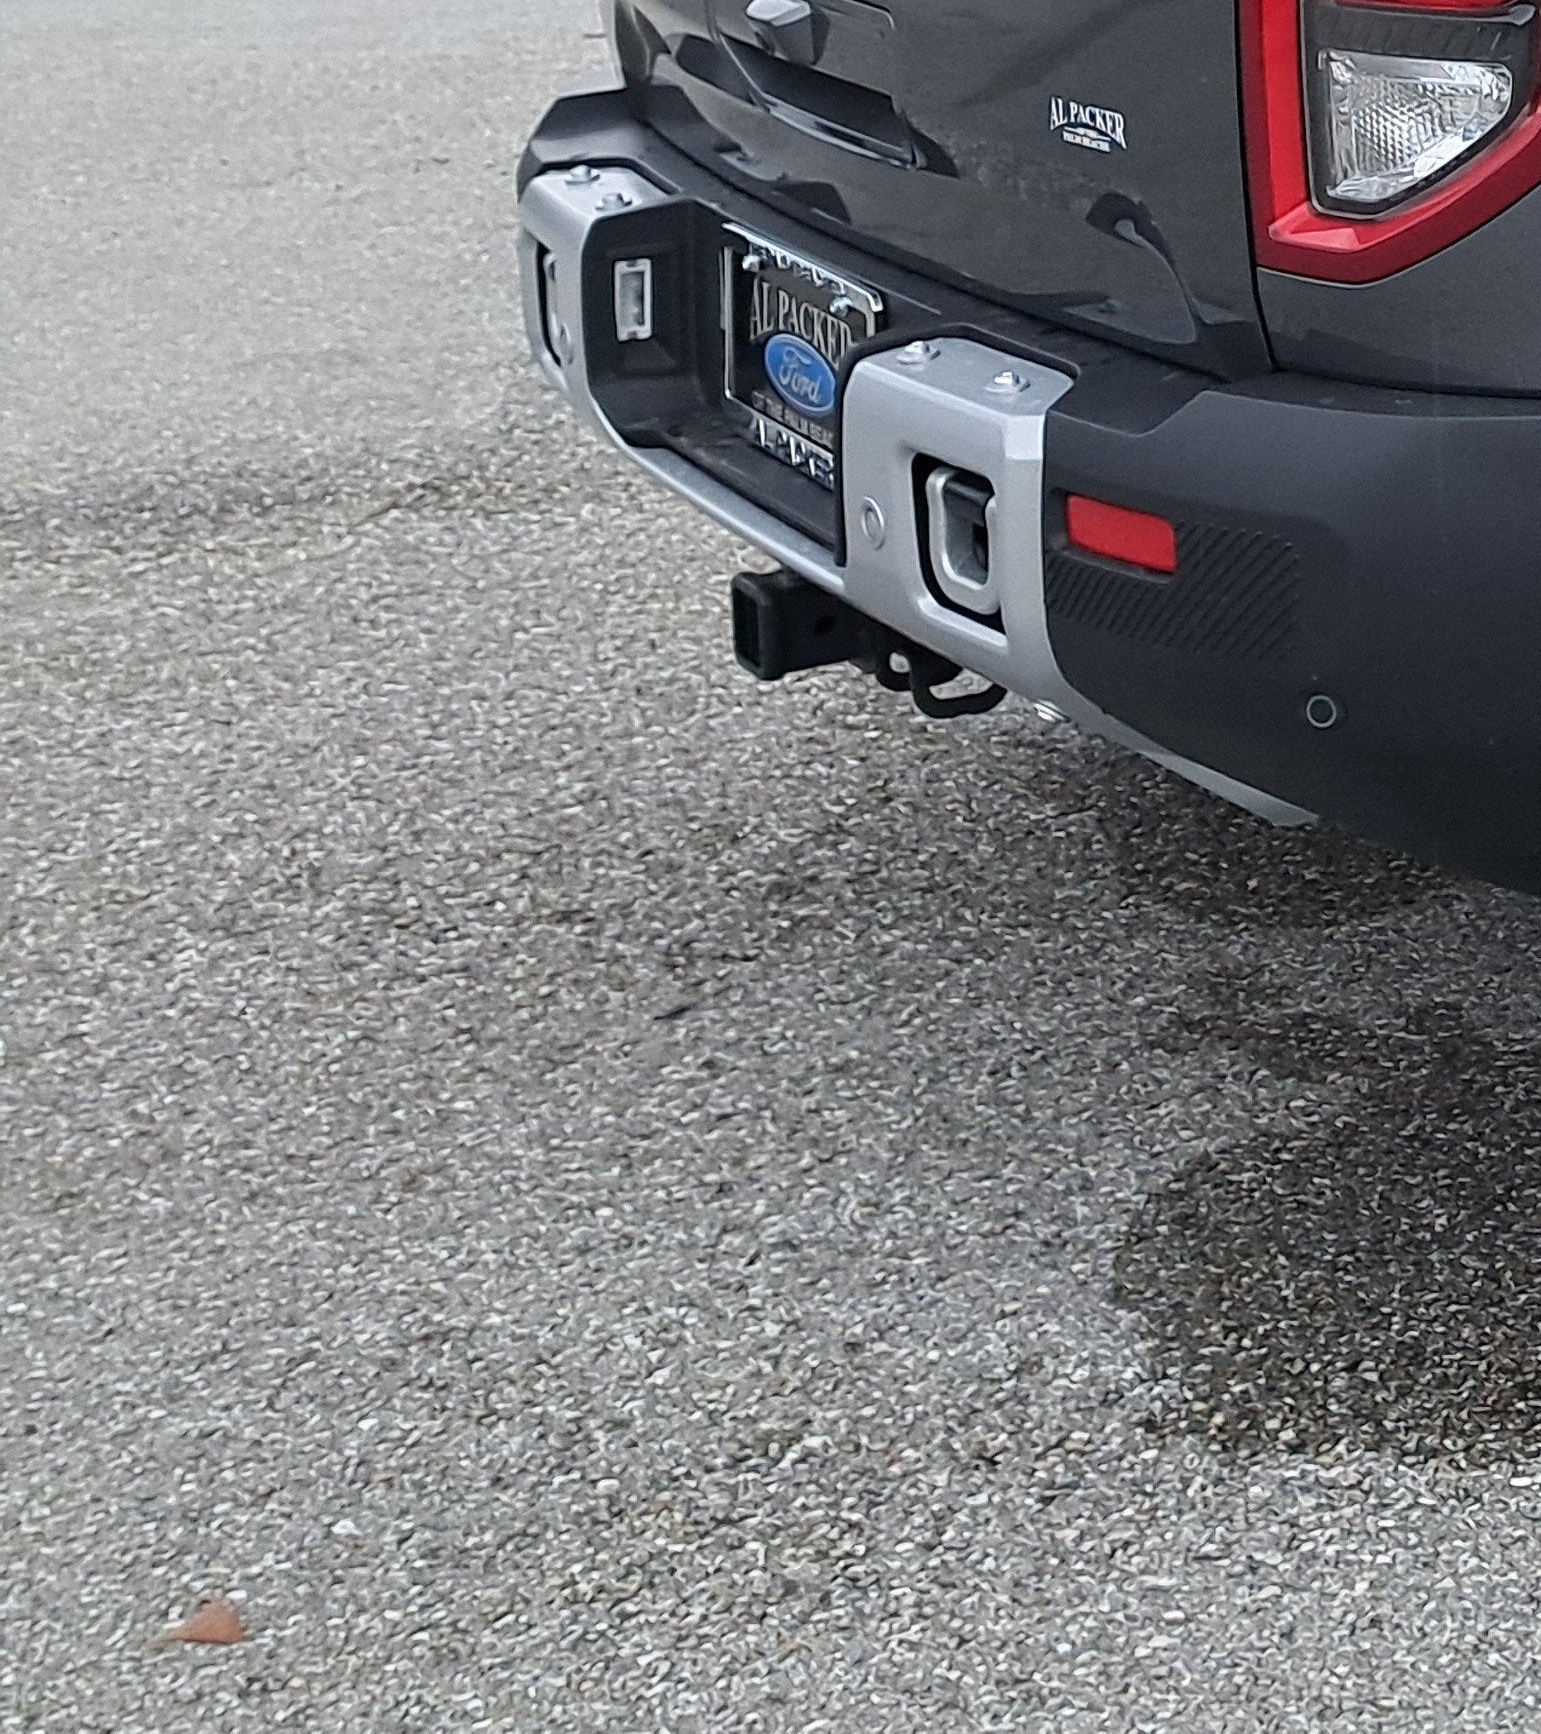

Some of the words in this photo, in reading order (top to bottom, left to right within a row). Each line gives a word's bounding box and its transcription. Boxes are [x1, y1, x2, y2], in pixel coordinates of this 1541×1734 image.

[1050, 96, 1068, 131] AL
[1069, 100, 1127, 149] PACKER
[751, 276, 774, 340] AL
